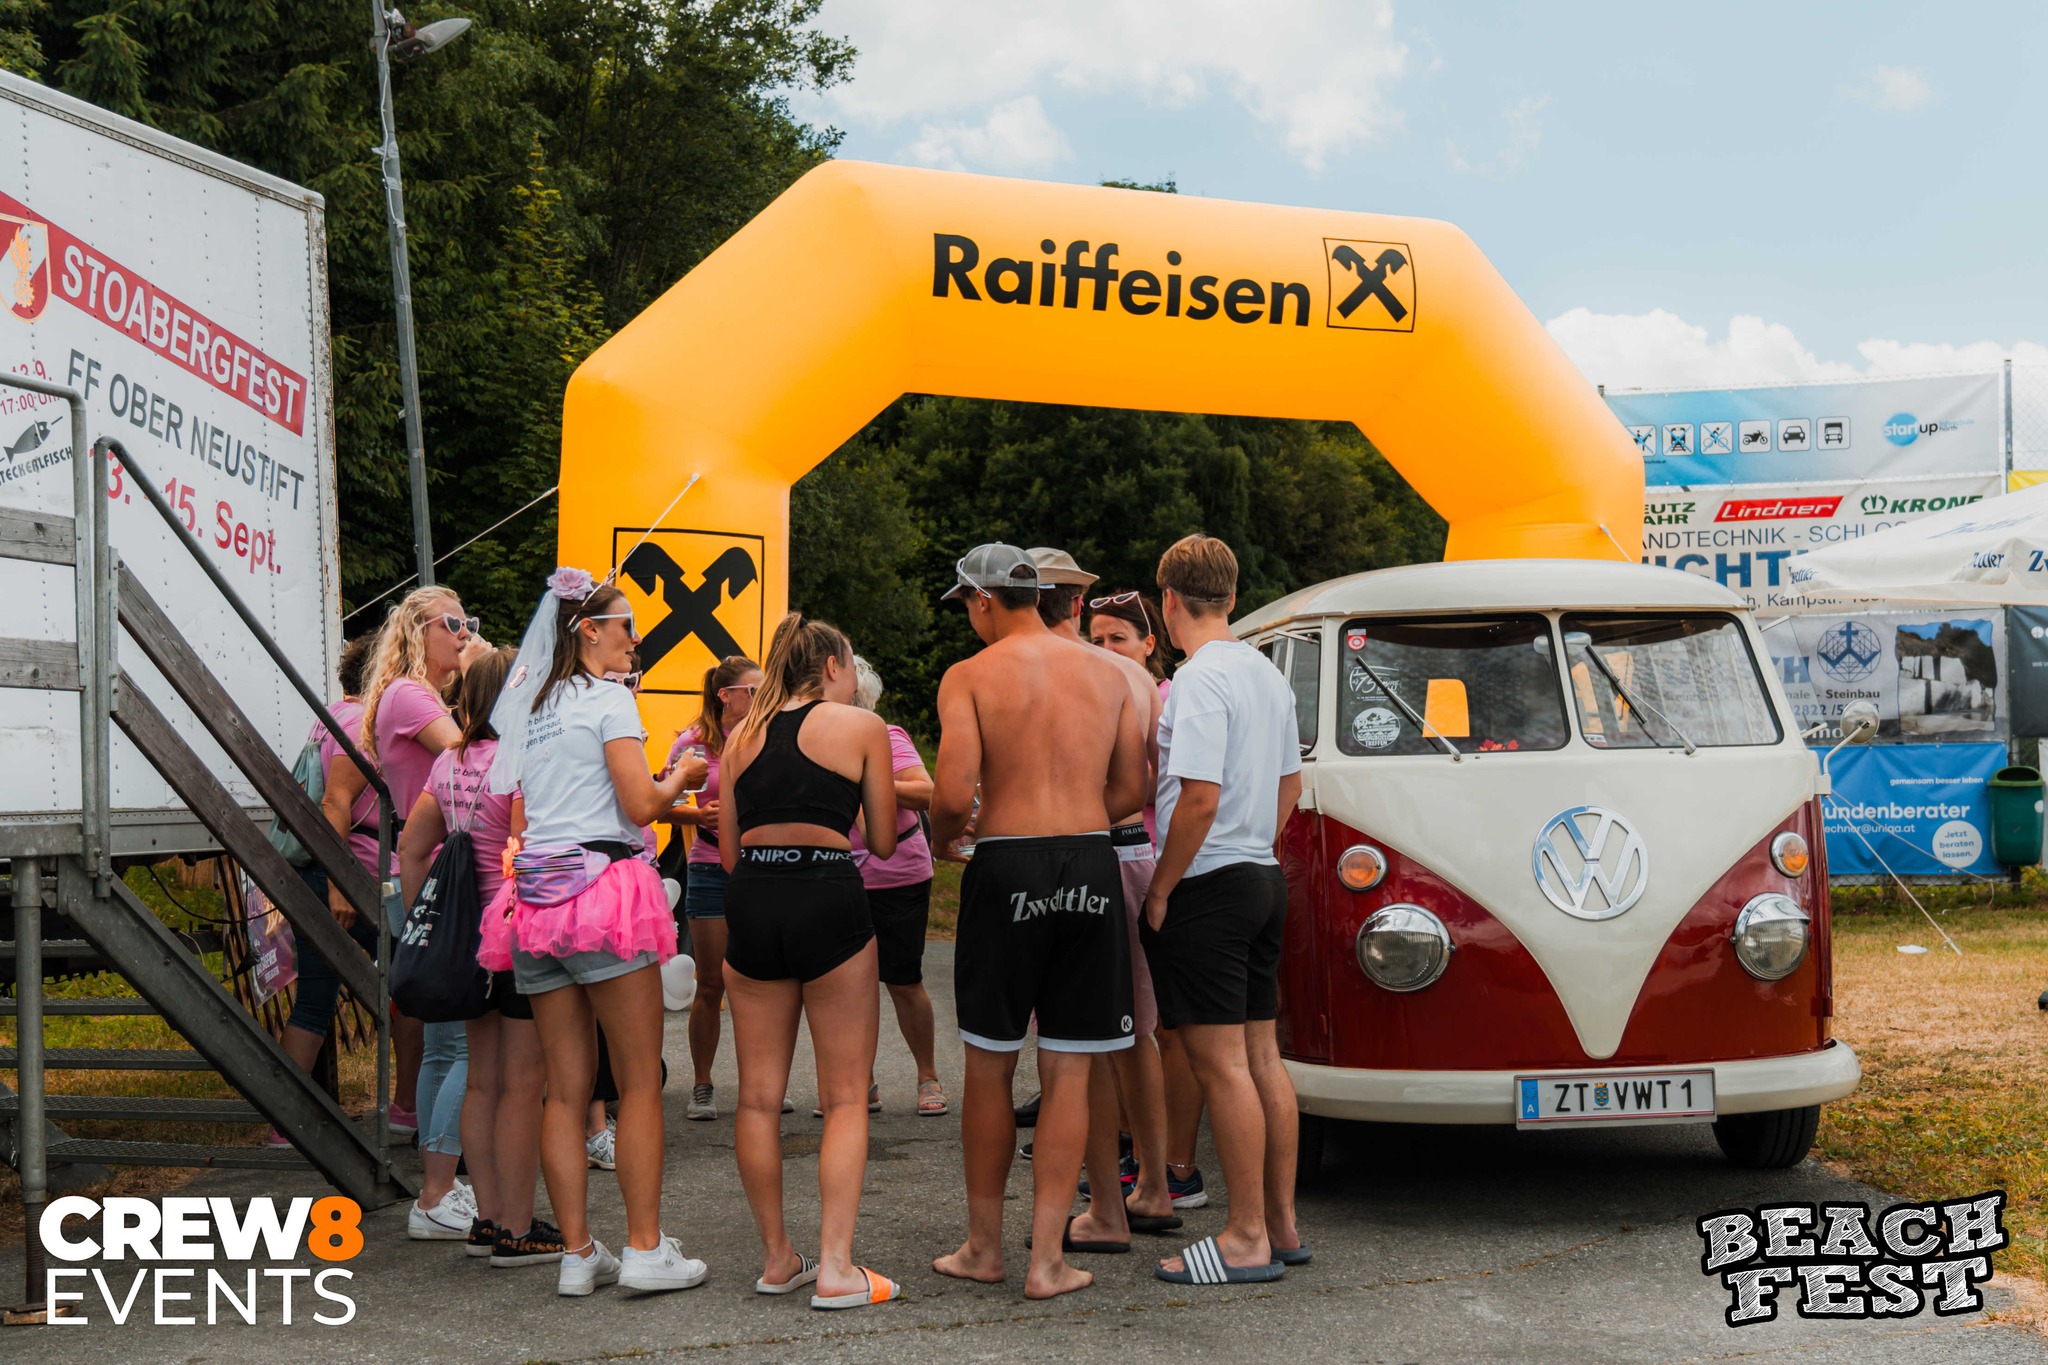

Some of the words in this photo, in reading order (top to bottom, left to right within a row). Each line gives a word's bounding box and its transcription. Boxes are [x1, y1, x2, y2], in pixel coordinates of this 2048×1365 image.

[932, 232, 1311, 327] Raiffeisen
[61, 244, 301, 424] STOABERGFEST
[68, 348, 102, 401] FF
[109, 373, 183, 450] OBER
[190, 415, 305, 511] NEUSTIFT
[0, 446, 73, 486] TECKERLFISCH
[89, 448, 131, 505] 3.
[165, 476, 203, 538] 15.
[214, 500, 281, 574] Sept.
[1644, 515, 1689, 525] AHR
[1721, 501, 1834, 520] Lindner
[1642, 527, 1786, 550] NDTECHNIK
[1826, 689, 1880, 699] Steinbau
[1890, 778, 1934, 787] gemeinsam
[1935, 777, 1961, 785] besser
[1962, 776, 1984, 785] leben
[1939, 840, 1975, 849] beraten
[1944, 829, 1968, 839] Jetzt
[1942, 850, 1974, 859] lassen.
[1526, 1104, 1535, 1113] A
[1554, 1083, 1589, 1112] ZT
